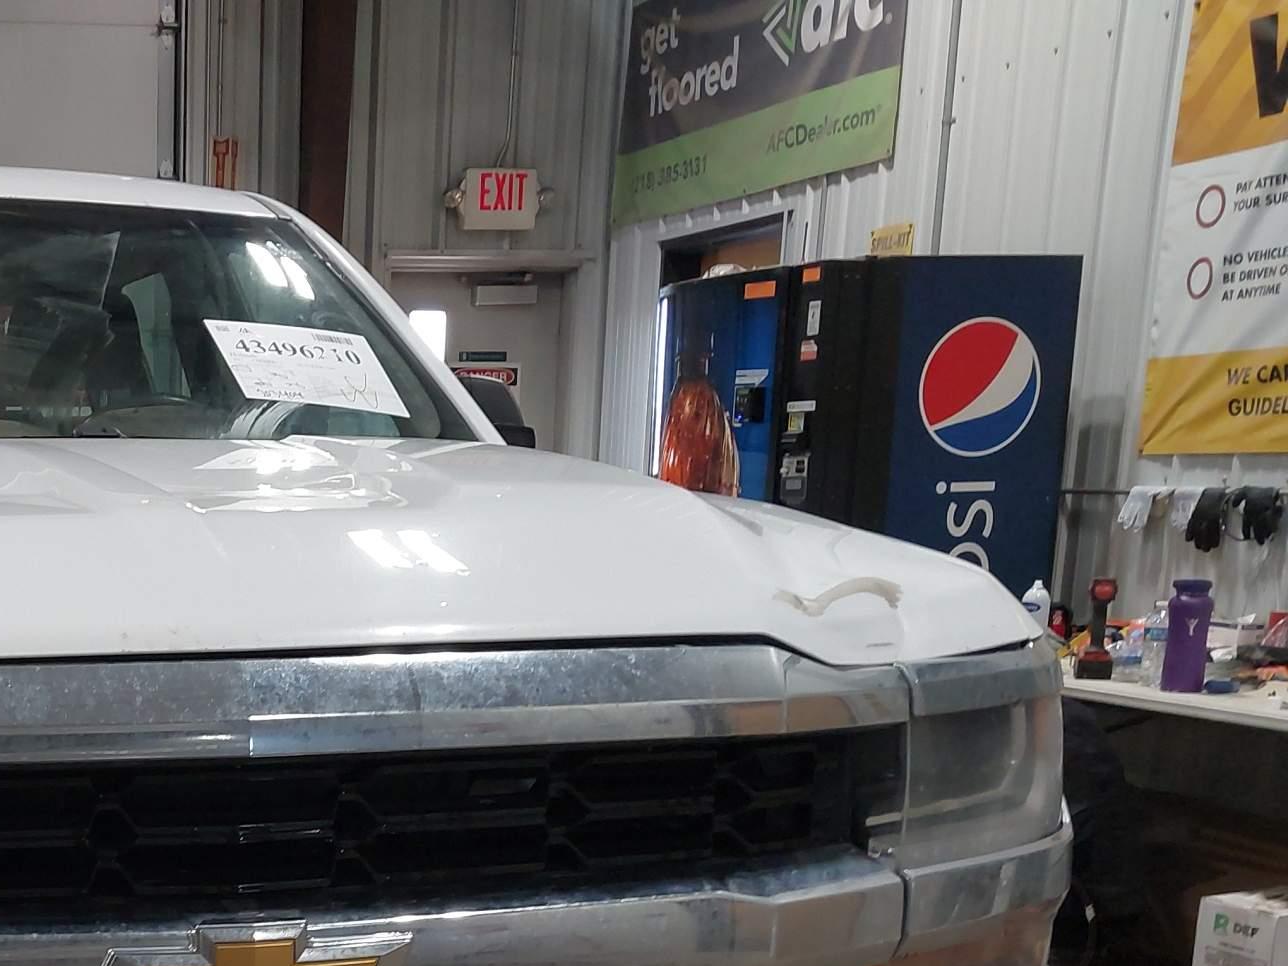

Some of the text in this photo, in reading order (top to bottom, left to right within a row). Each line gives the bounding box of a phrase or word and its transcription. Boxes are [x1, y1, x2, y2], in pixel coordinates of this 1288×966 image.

[640, 8, 680, 75] get
[649, 34, 740, 117] floored
[479, 173, 528, 211] EXIT
[1235, 181, 1253, 195] PAY
[1233, 196, 1260, 214] YOUR
[1223, 253, 1243, 267] NO
[1222, 271, 1235, 285] BE
[1239, 266, 1277, 282] DRIVEN
[1222, 282, 1282, 302] AT ANYTIME
[235, 339, 361, 365] 43496210
[1227, 367, 1252, 385] WE
